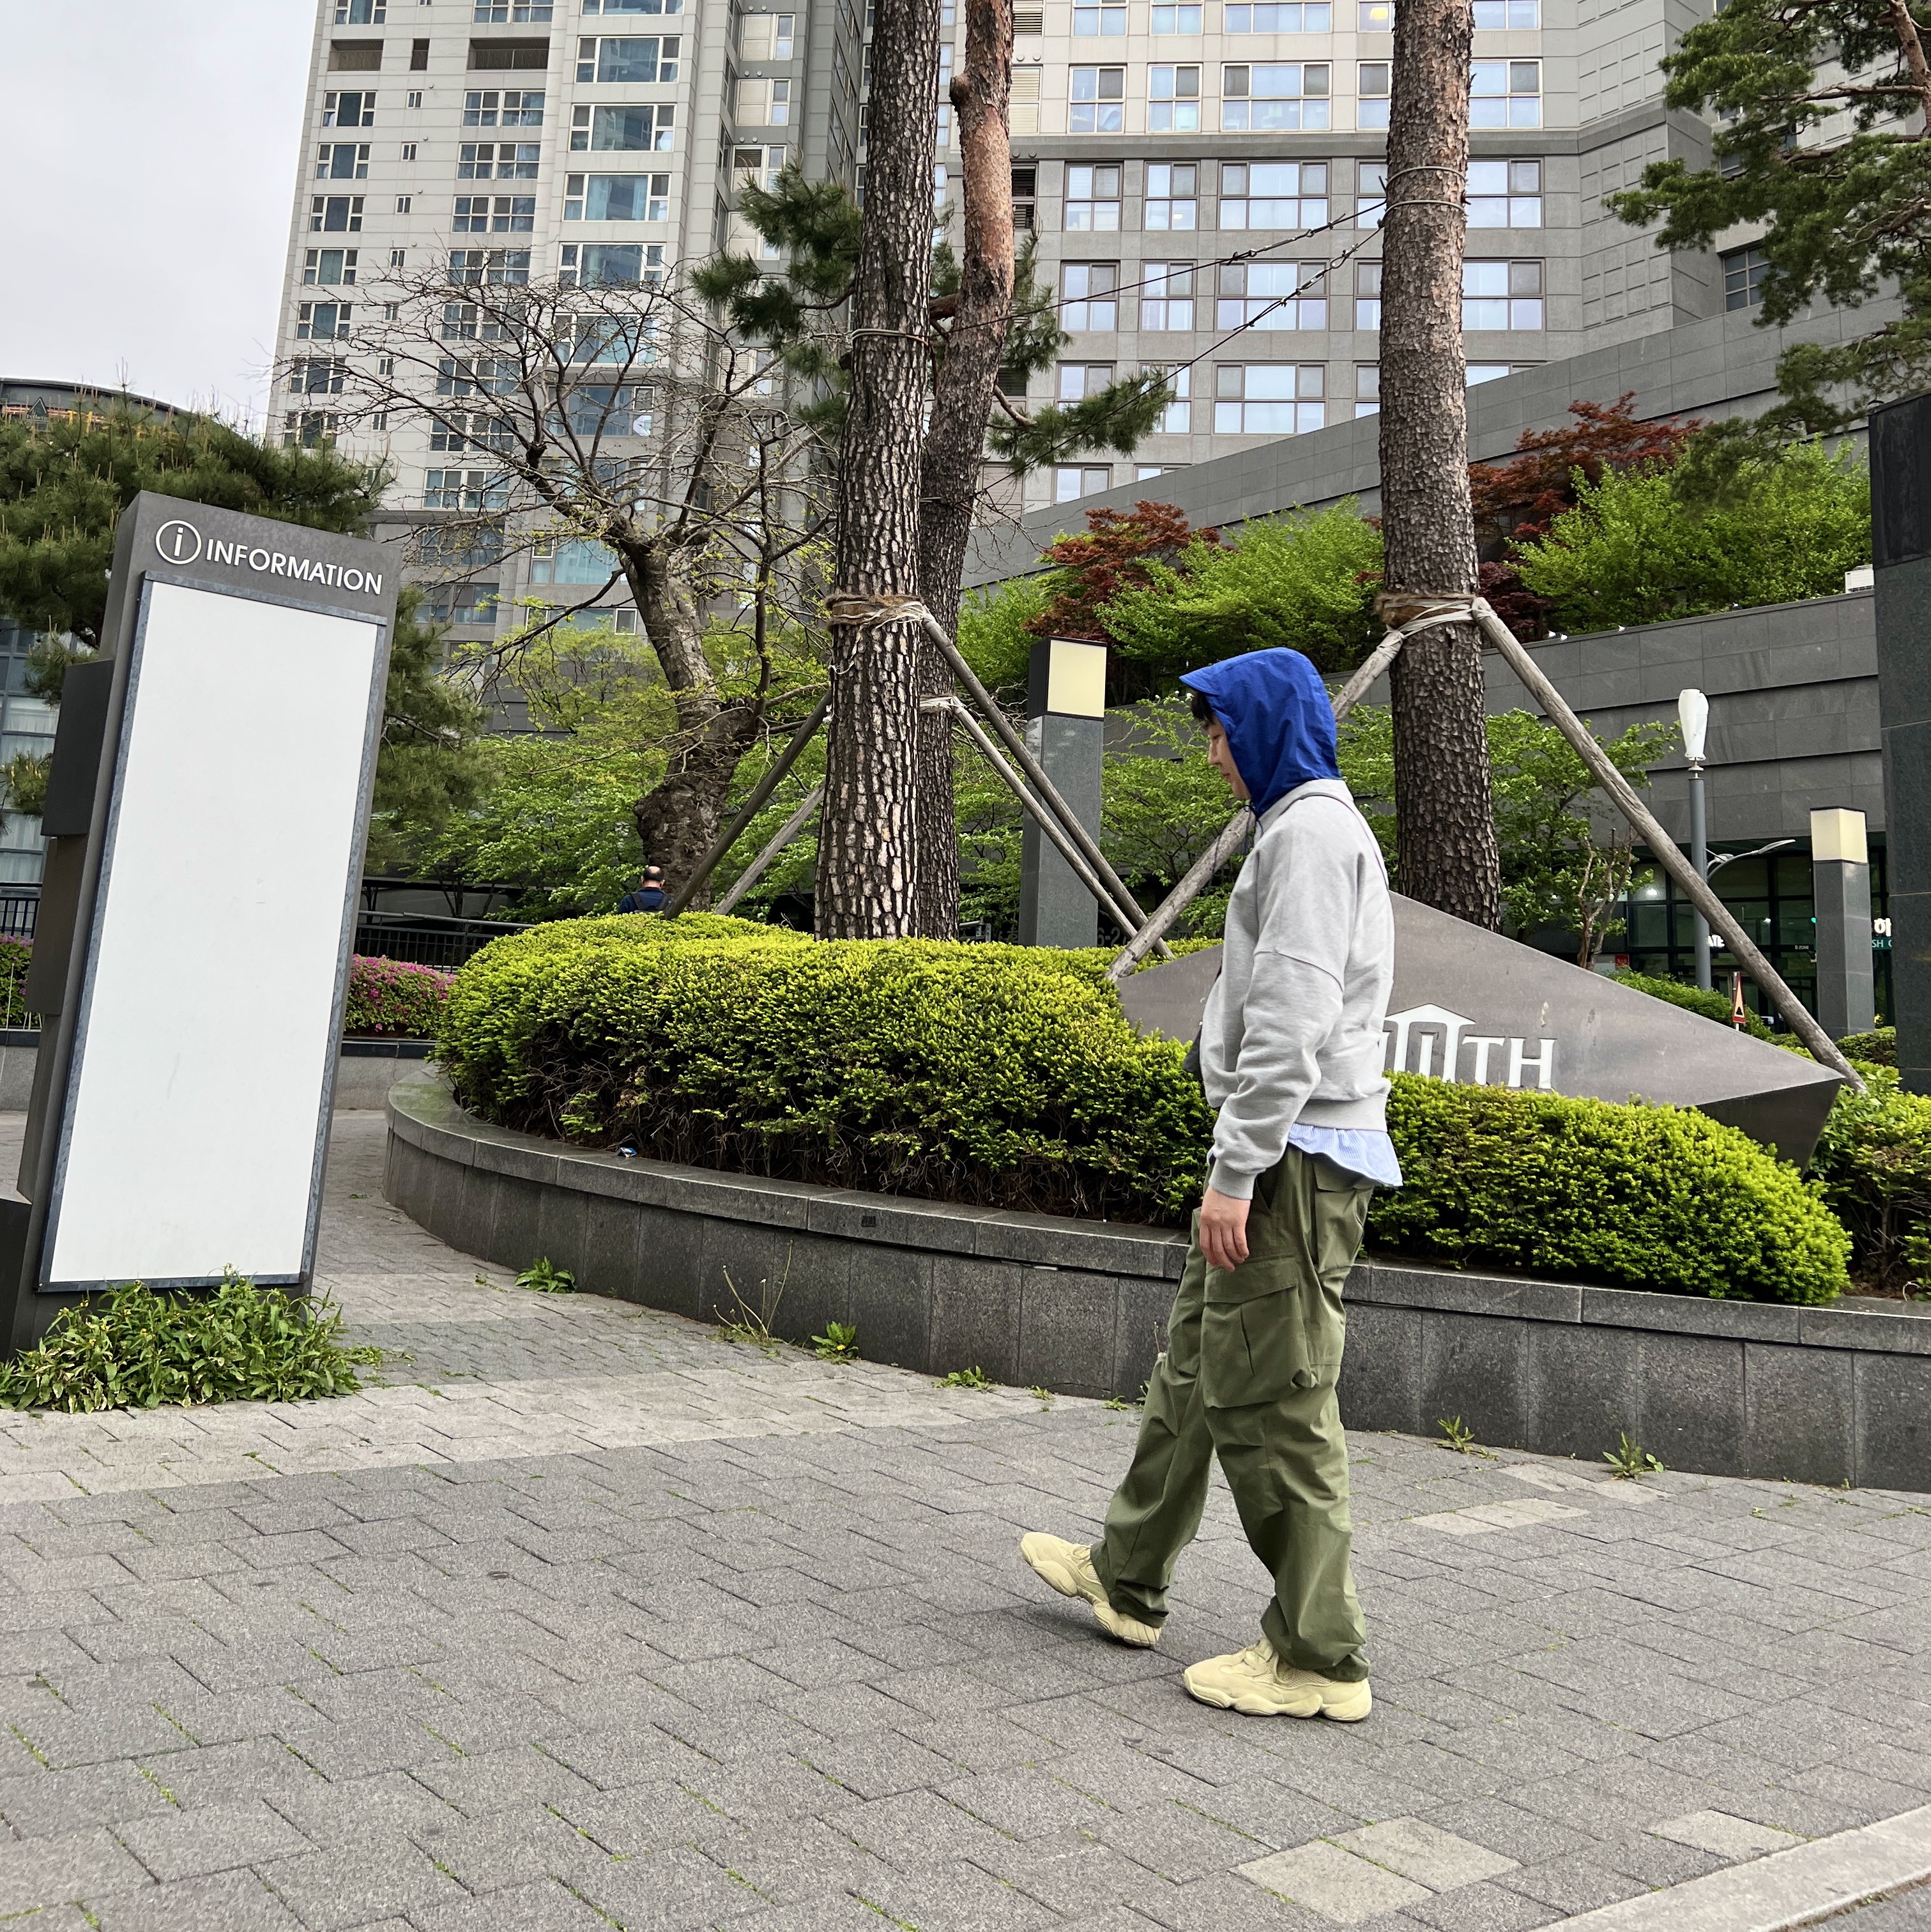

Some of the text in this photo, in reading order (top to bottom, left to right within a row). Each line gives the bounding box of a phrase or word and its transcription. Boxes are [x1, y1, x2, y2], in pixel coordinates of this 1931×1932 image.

[206, 538, 383, 595] INFORMATION
[1097, 926, 1127, 947] 6-2
[1872, 939, 1884, 948] SH
